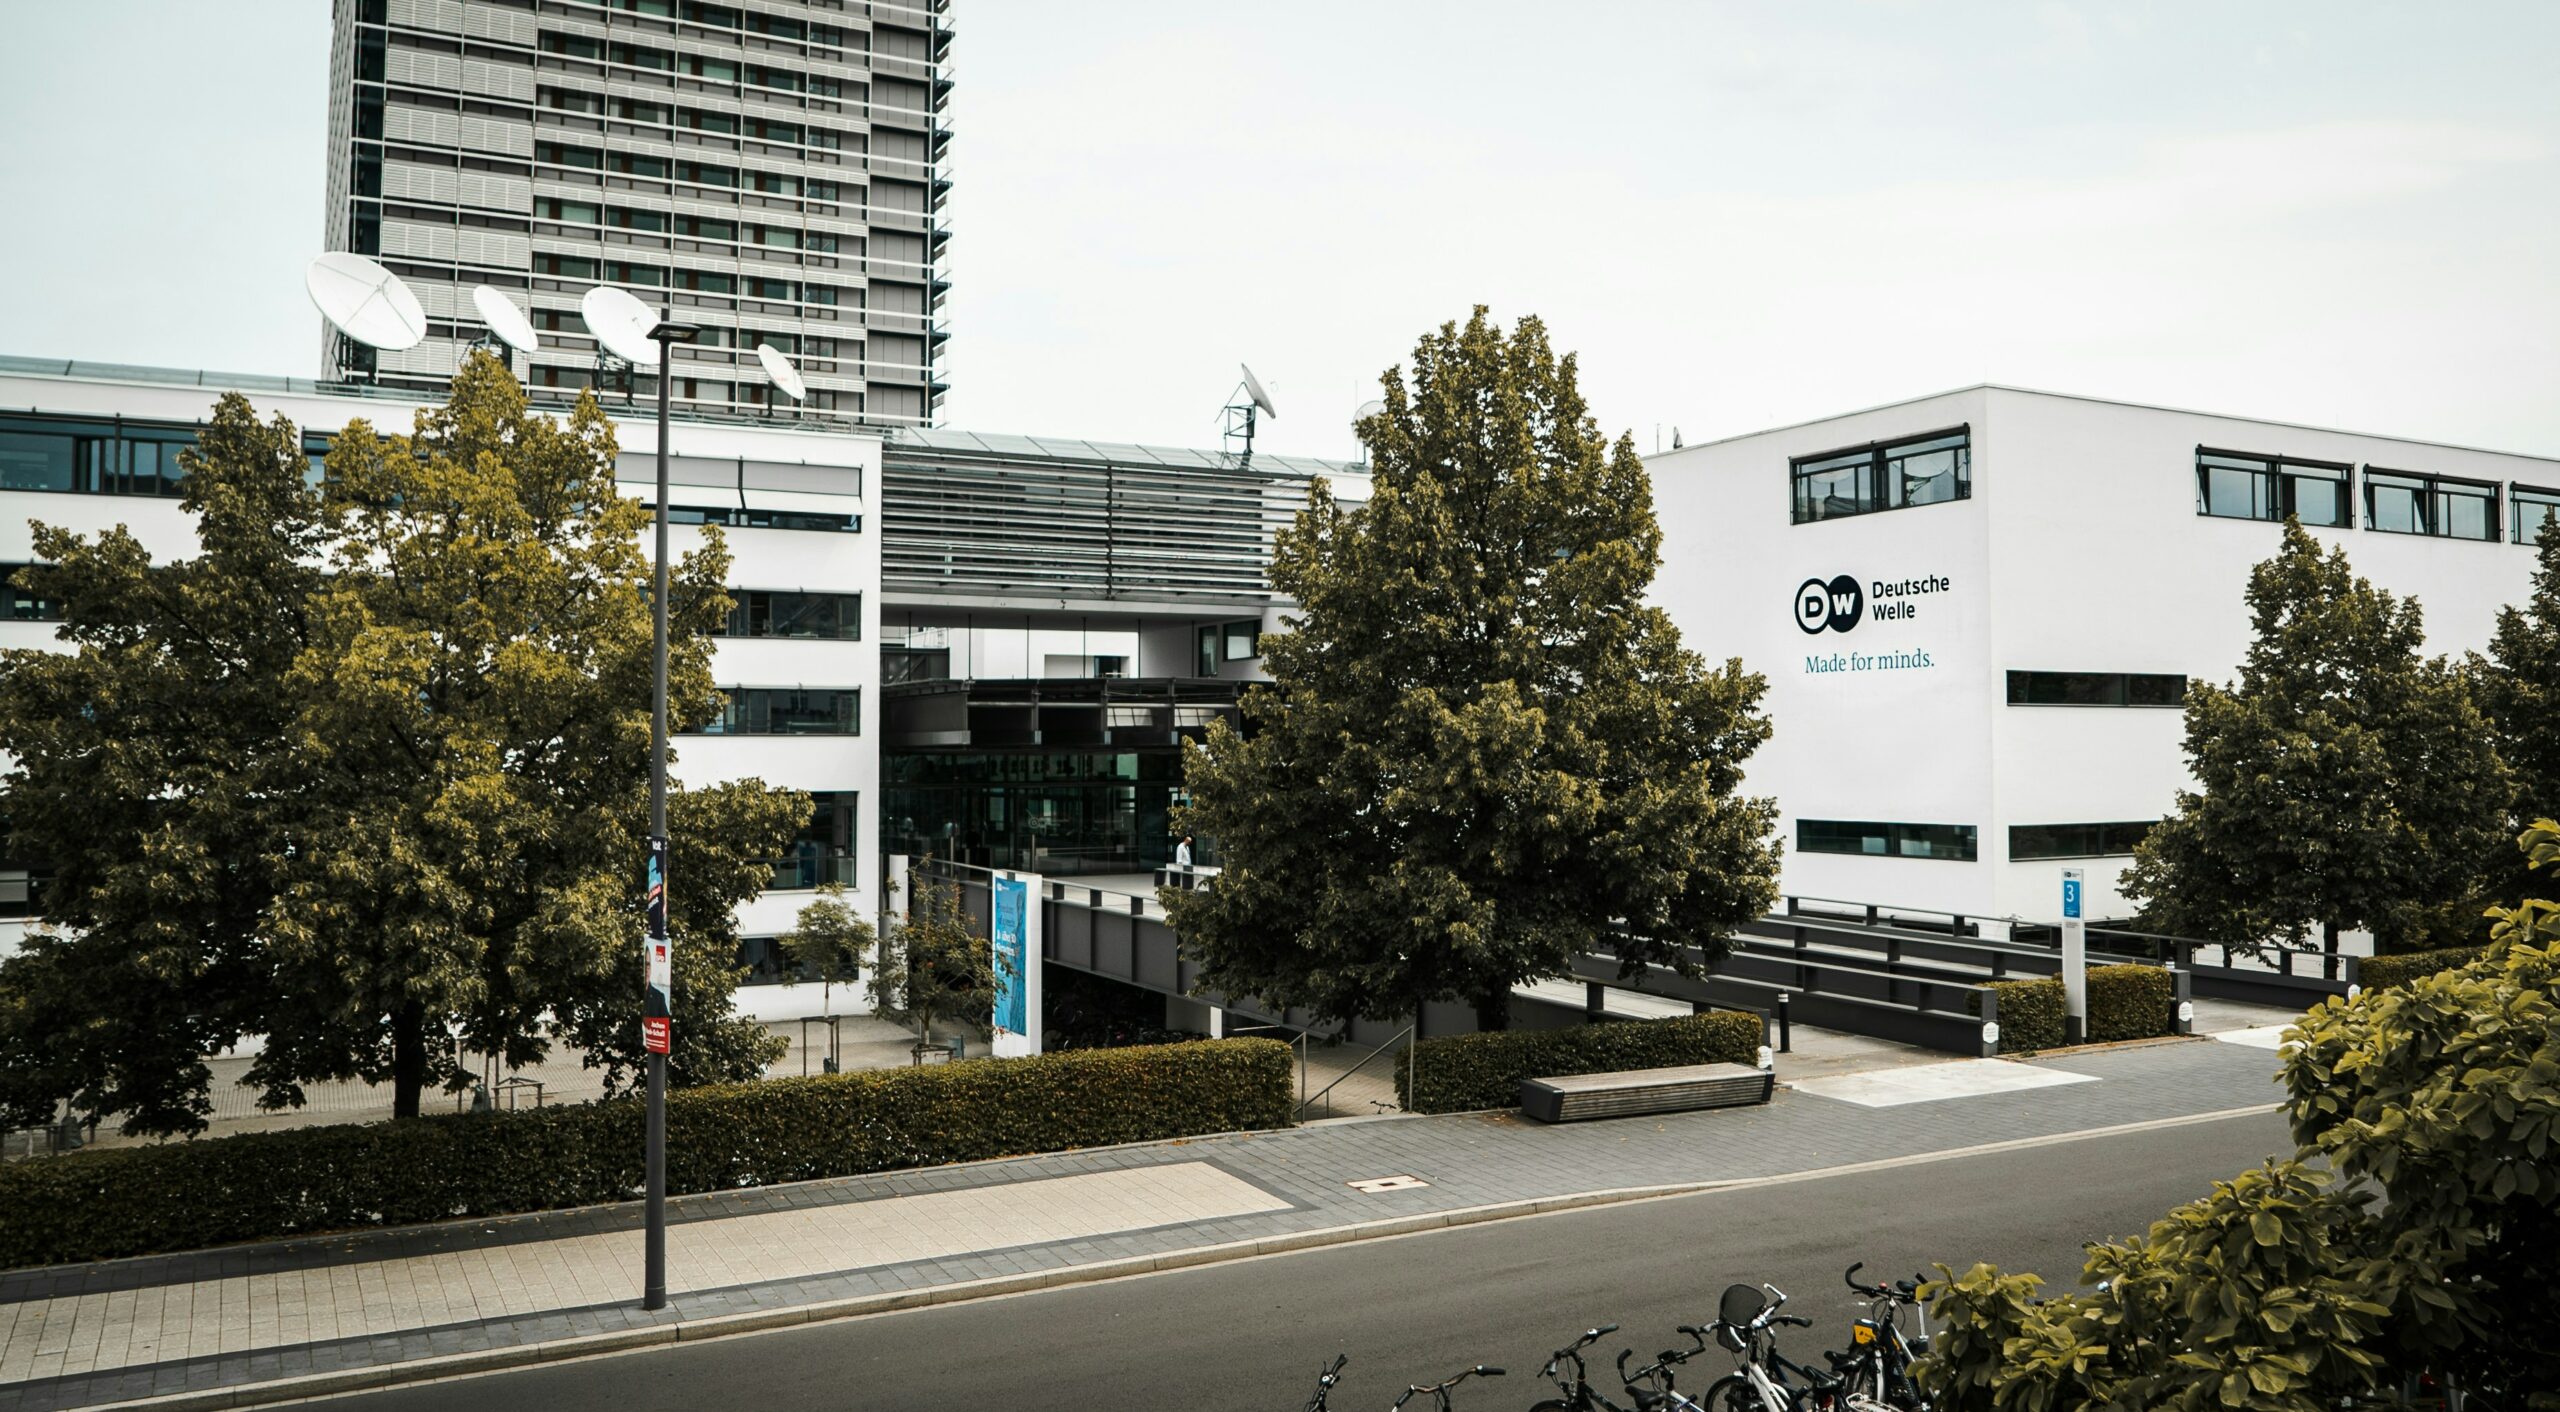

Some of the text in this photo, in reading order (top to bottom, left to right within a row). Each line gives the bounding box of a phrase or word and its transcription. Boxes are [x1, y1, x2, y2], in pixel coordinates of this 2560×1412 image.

[1872, 574, 1950, 599] Deutsche
[1872, 601, 1915, 621] Welle
[1805, 647, 1935, 674] Made for minds.
[2066, 884, 2074, 903] 3
